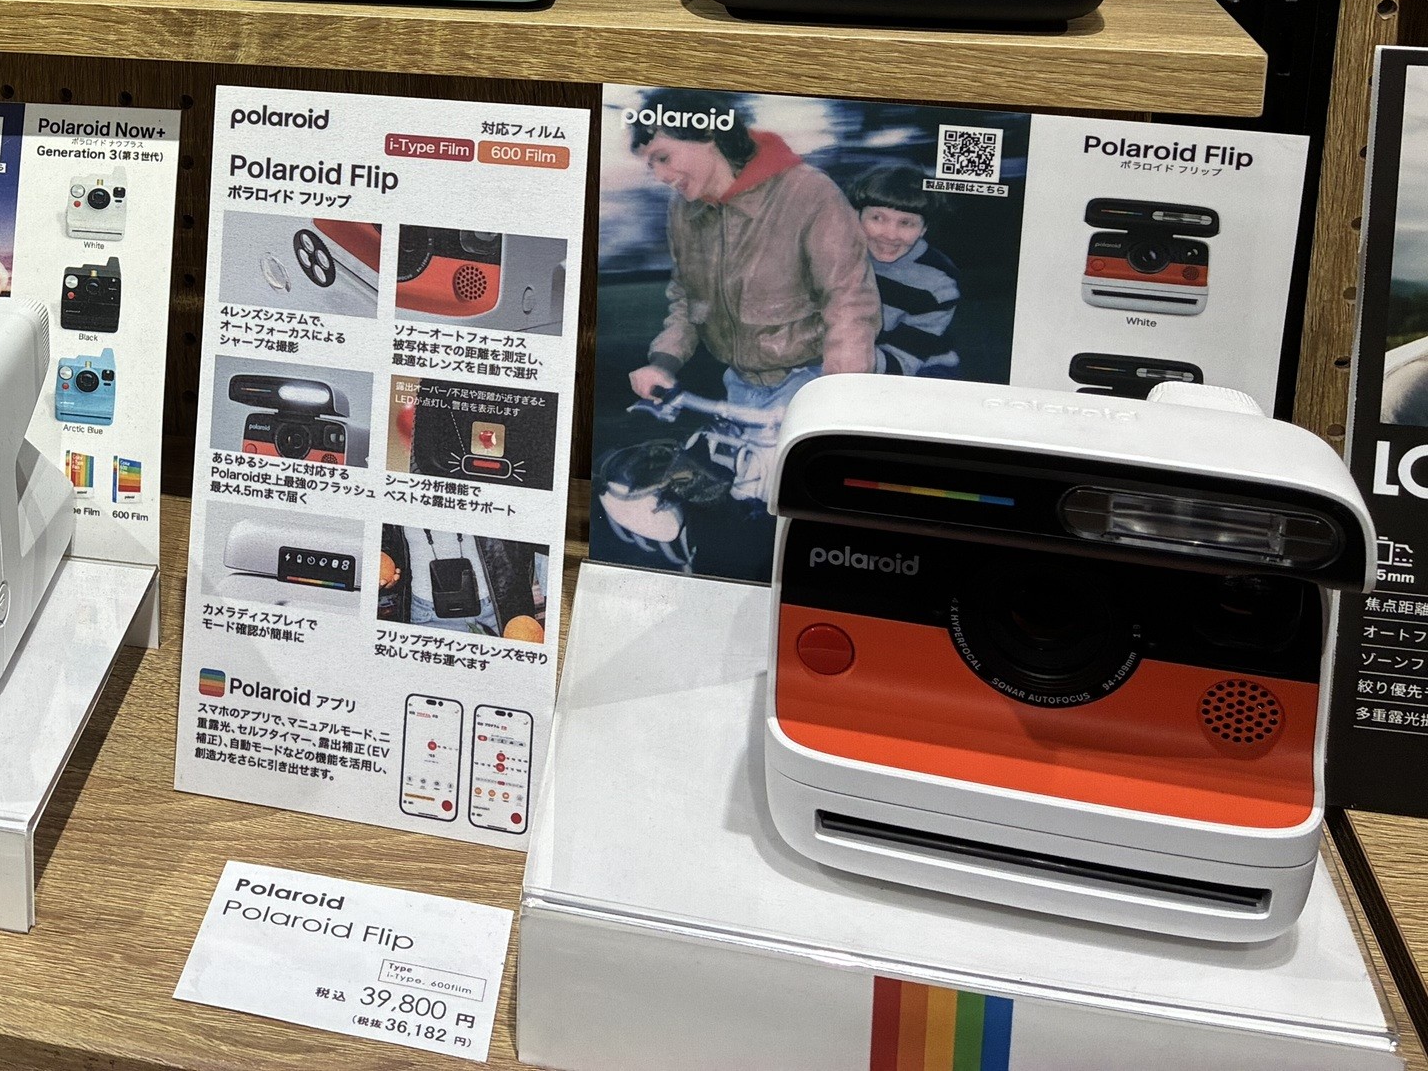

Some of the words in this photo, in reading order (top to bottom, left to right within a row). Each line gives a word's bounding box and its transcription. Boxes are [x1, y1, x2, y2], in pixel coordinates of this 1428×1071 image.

[38, 118, 110, 136] Polaroid
[115, 122, 166, 139] Now+
[230, 105, 329, 130] polaroid
[620, 104, 734, 131] polaroid
[481, 121, 566, 140] 対応フィルム
[37, 145, 105, 160] Generation
[72, 137, 106, 146] ポラロイド
[109, 139, 144, 148] ナウプラス
[390, 139, 435, 155] i-Type
[440, 143, 469, 157] Film
[1084, 135, 1196, 163] Polaroid
[1204, 145, 1254, 170] Flip
[491, 146, 521, 161] 600
[525, 149, 556, 163] Film
[229, 154, 341, 185] Polaroid
[351, 164, 399, 194] Flip
[1120, 160, 1174, 171] ポラロイド
[1178, 165, 1222, 177] フリップ
[227, 185, 294, 204] ポラロイド
[300, 192, 352, 208] フリップ
[924, 180, 1006, 195] 製品詳細はこちら
[84, 241, 104, 249] White
[1094, 241, 1121, 249] polaroid
[220, 321, 346, 344] オートフォーカスによる
[1126, 317, 1157, 328] White
[79, 333, 98, 341] Black
[220, 334, 299, 354] シャープな撮影
[394, 325, 527, 349] ソナーオートフォーカス
[392, 339, 544, 367] 被写体までの距離を測定し、
[391, 354, 538, 380] 最適なレンズを自動で選択
[63, 424, 85, 434] Arctic
[87, 426, 103, 435] Blue
[249, 423, 270, 432] polaroid
[212, 452, 350, 480] あらゆるシーンに対応する
[210, 482, 308, 505] 最大4.5mまで届く
[211, 467, 376, 500] Polaroid史上最強のフラッシュ
[385, 475, 481, 497] シーン分析機能で
[84, 508, 100, 516] Film
[384, 490, 516, 517] ベストな露出をサポート
[113, 511, 129, 519] 600
[132, 513, 148, 521] Film
[809, 546, 919, 576] polaroid
[202, 603, 318, 631] カメラディスプレイで
[1365, 597, 1428, 616] 焦点距離
[201, 618, 305, 643] モード確認が簡単に
[375, 630, 548, 665] フリップデザインでレンズを守り
[950, 614, 981, 671] HYPERFOCAL
[374, 645, 490, 671] 安心して持ち運べます
[1102, 651, 1137, 690] 94-109mm
[229, 678, 311, 706] Polaroid
[316, 693, 357, 713] アプリ
[992, 677, 1026, 698] SONAR
[1028, 692, 1090, 704] AUTOFOCUS
[235, 878, 345, 910] Polaroid
[222, 900, 353, 939] Polaroid
[362, 926, 414, 952] Flip
[388, 963, 412, 974] Type
[431, 980, 472, 995] 600film
[315, 987, 346, 1002] 税込
[359, 987, 447, 1020] 39,800
[455, 1013, 475, 1029] 円
